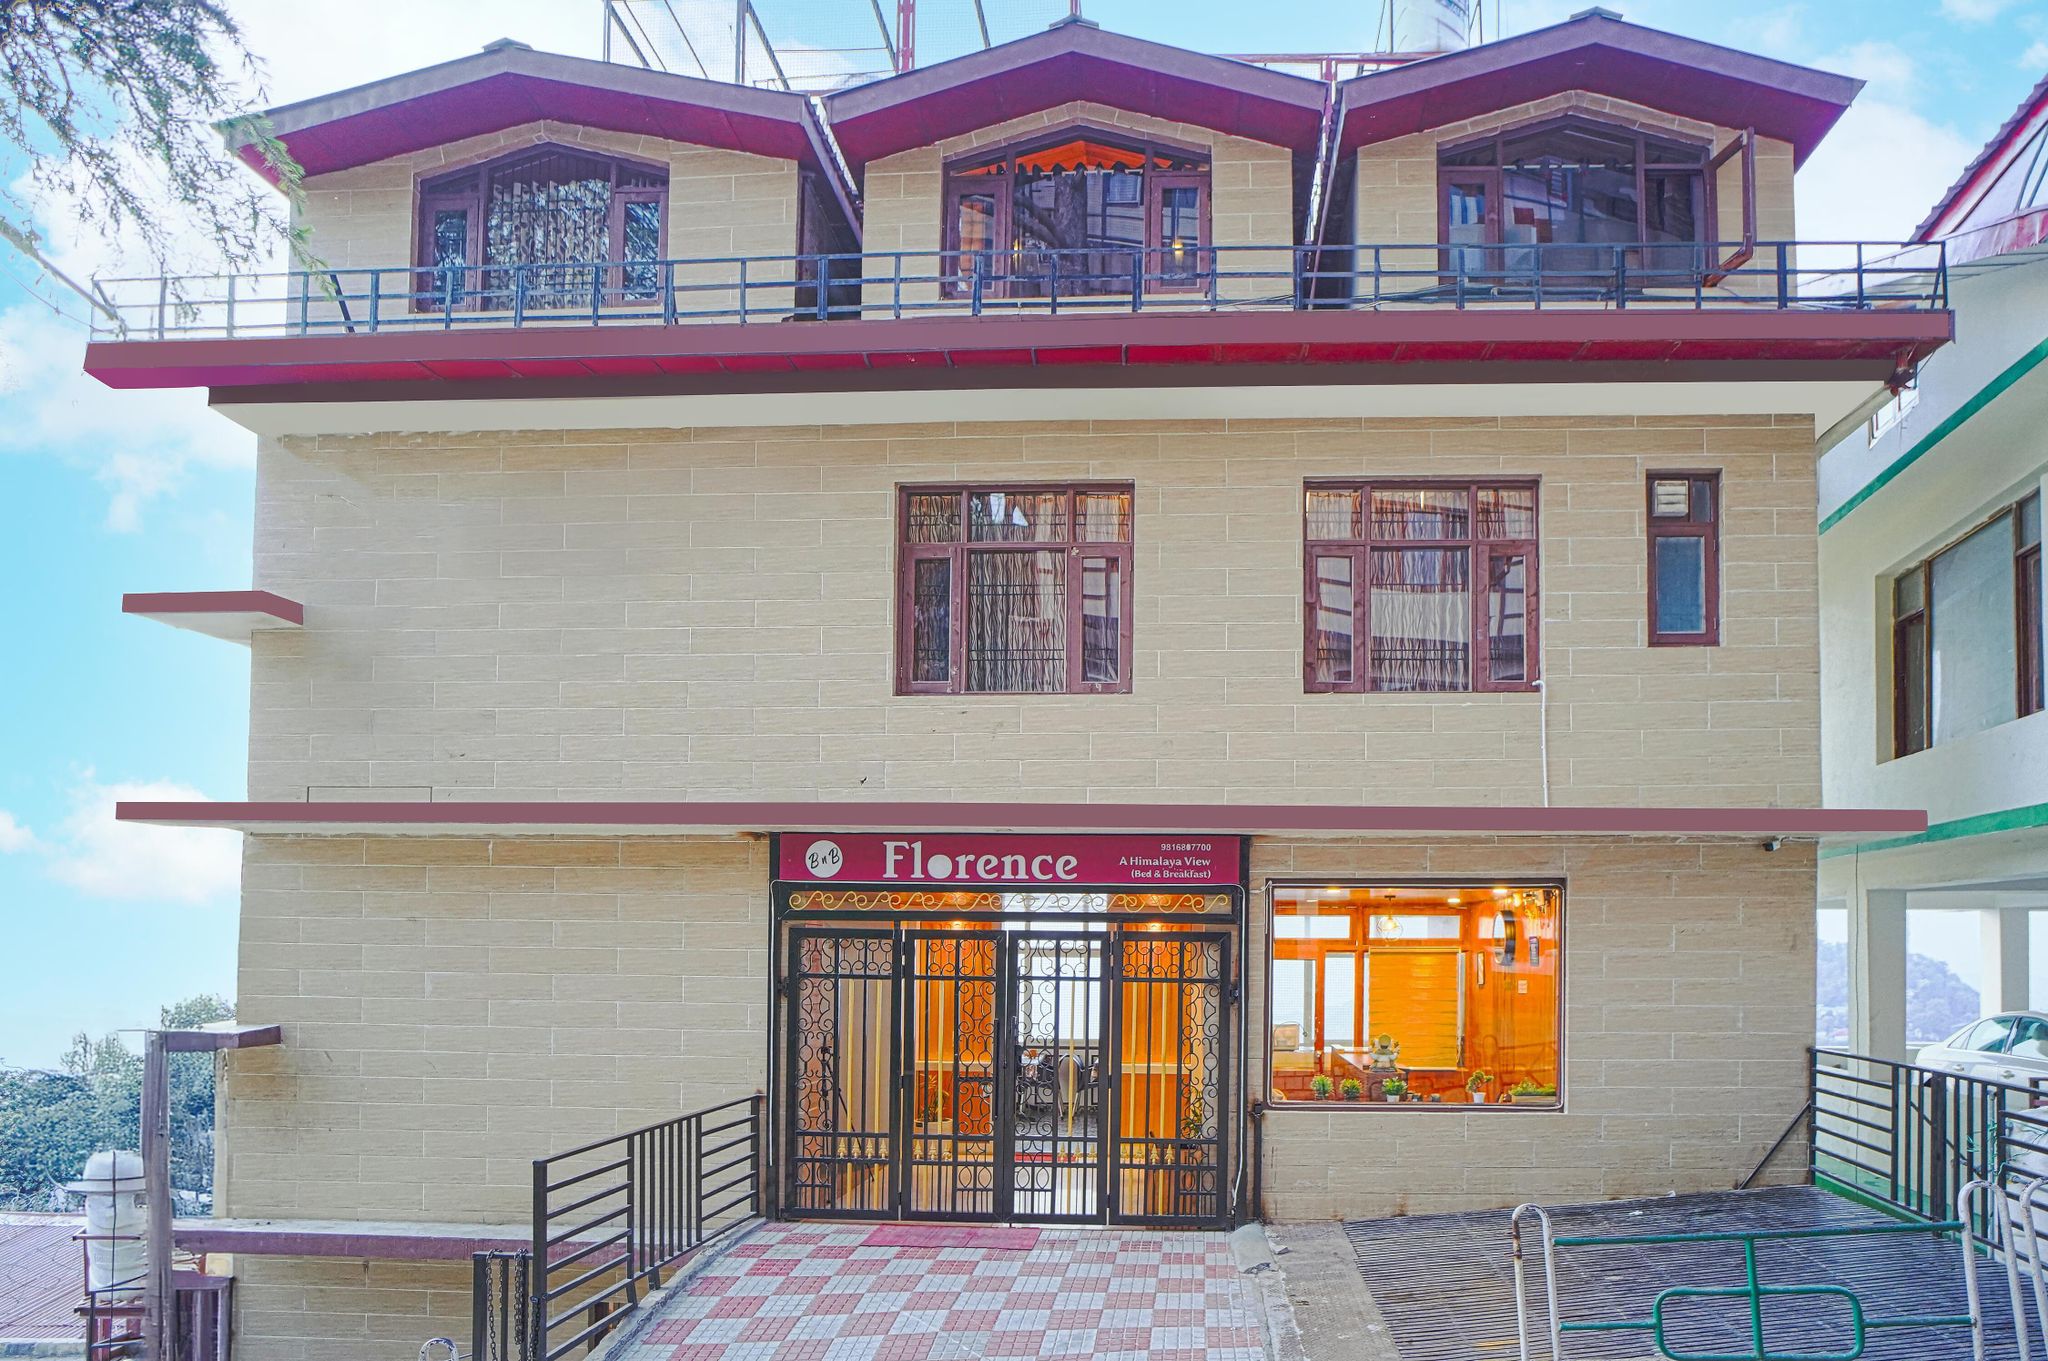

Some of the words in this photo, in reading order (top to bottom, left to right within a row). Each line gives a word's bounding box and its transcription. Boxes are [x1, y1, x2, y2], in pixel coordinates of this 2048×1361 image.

[882, 841, 1078, 880] Florence
[1119, 857, 1128, 866] A
[1130, 856, 1182, 868] Himalaya
[1184, 856, 1211, 866] View
[1131, 869, 1152, 879] (Bed
[1154, 870, 1161, 878] &
[1163, 869, 1211, 879] Breakfast)
